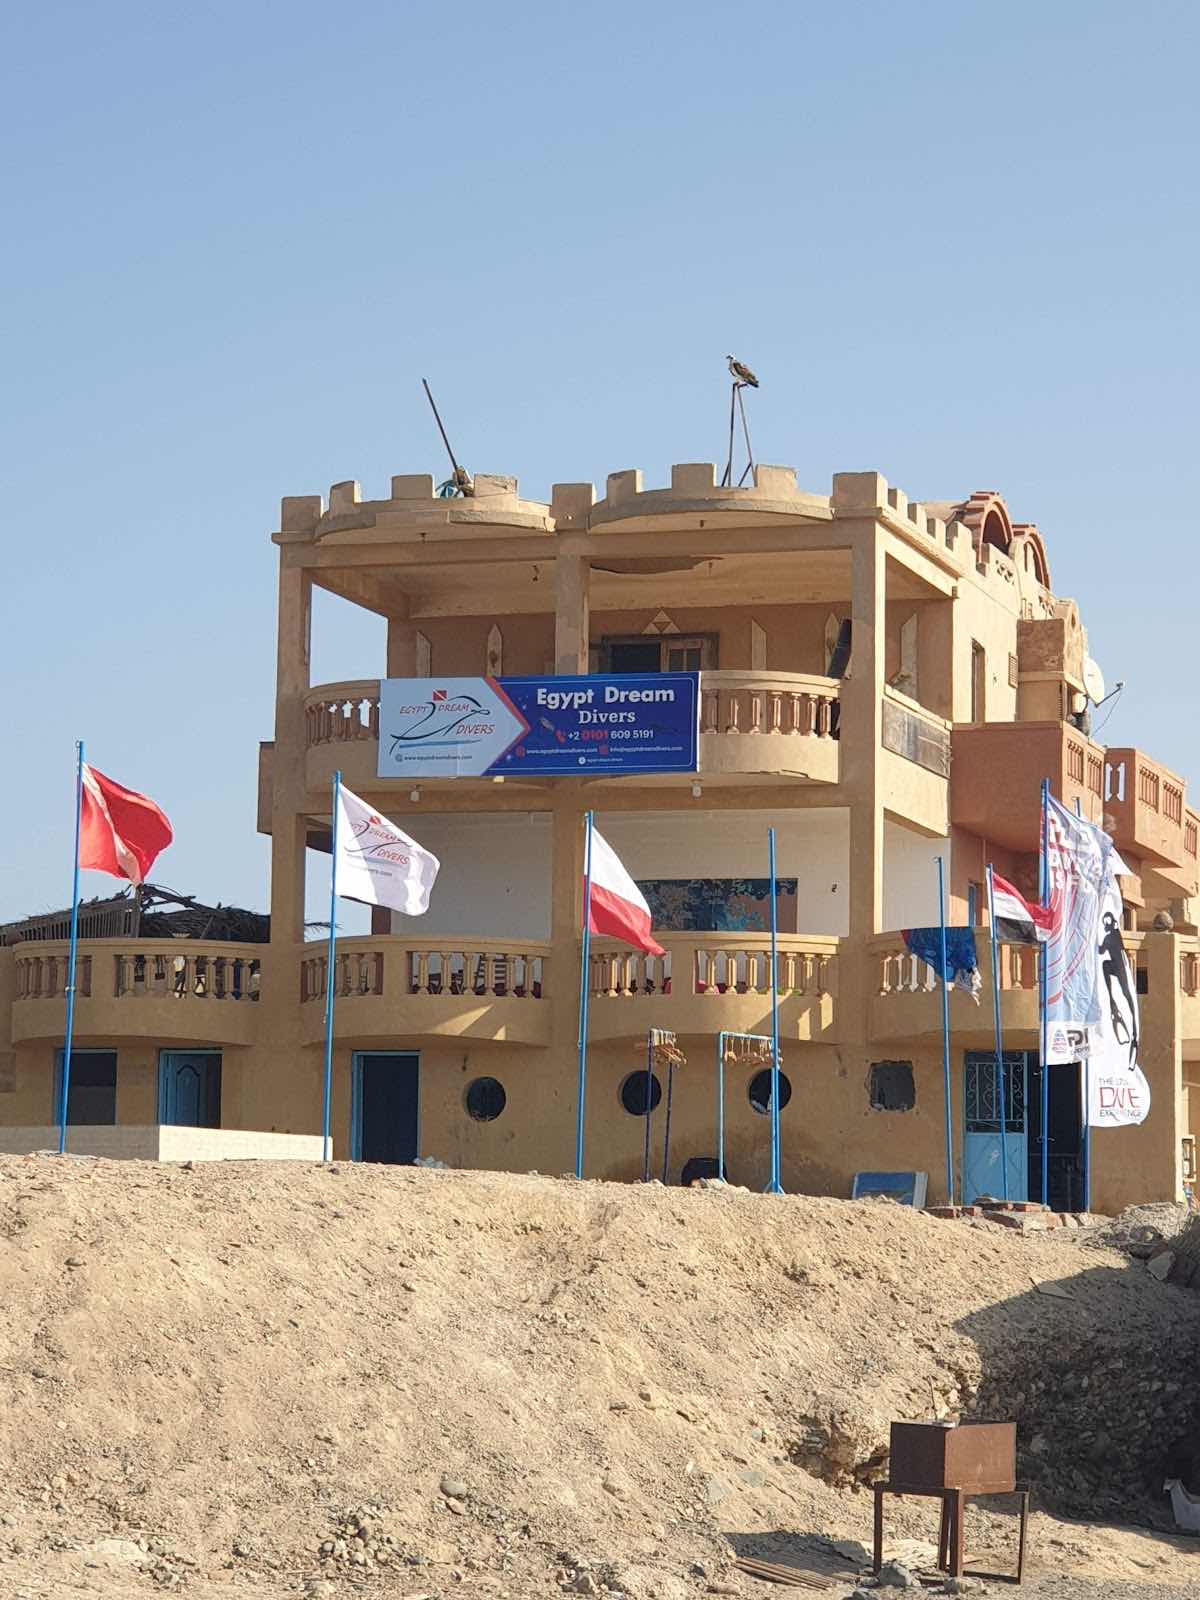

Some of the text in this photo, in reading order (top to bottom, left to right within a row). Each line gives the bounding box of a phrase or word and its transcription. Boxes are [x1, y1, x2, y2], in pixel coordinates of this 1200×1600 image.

[537, 686, 675, 709] Egypt Dream
[400, 703, 470, 714] EGYPT DREAM
[578, 709, 636, 724] Divers
[455, 724, 496, 735] DIVERS
[567, 731, 580, 741] +2
[610, 729, 631, 739] 609
[633, 729, 654, 739] 5191
[377, 848, 410, 865] DIVERS
